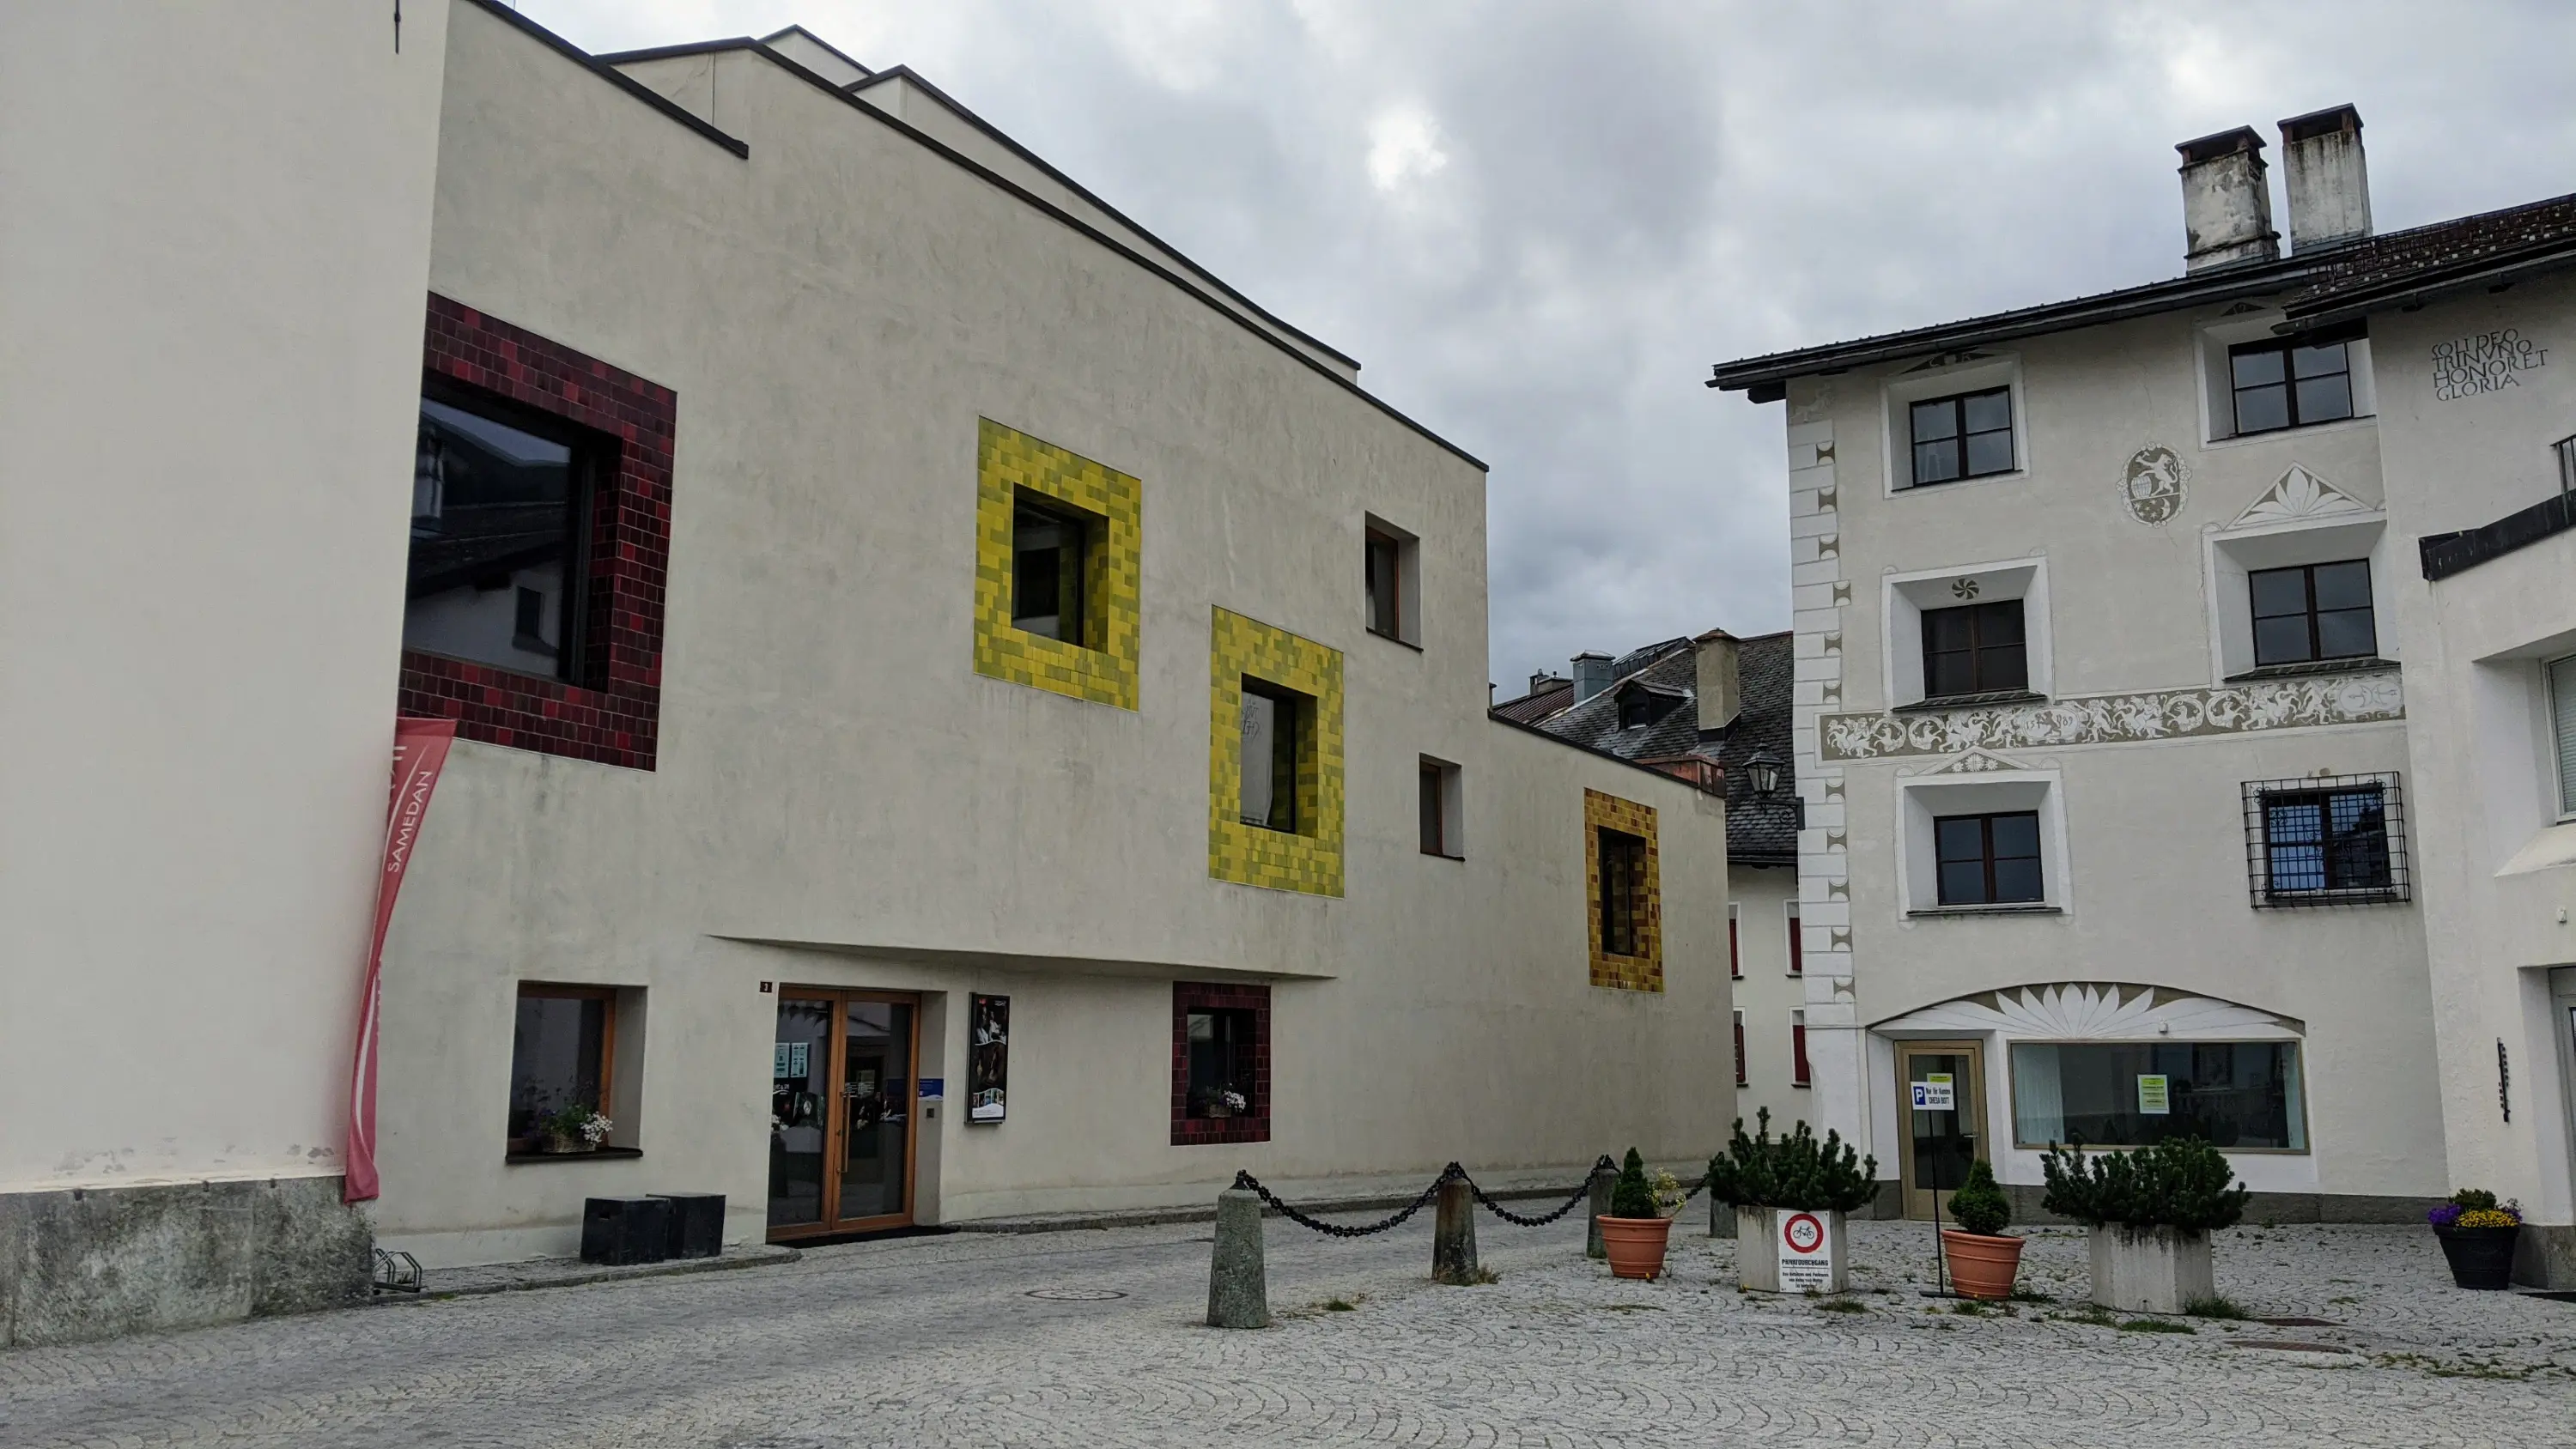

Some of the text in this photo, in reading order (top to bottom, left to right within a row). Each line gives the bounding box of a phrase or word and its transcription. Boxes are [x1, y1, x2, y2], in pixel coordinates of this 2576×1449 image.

[2432, 329, 2518, 357] SOLI DEO
[2436, 373, 2521, 401] GLORIA
[387, 770, 433, 873] SAMEDAN
[1915, 1088, 1923, 1102] P
